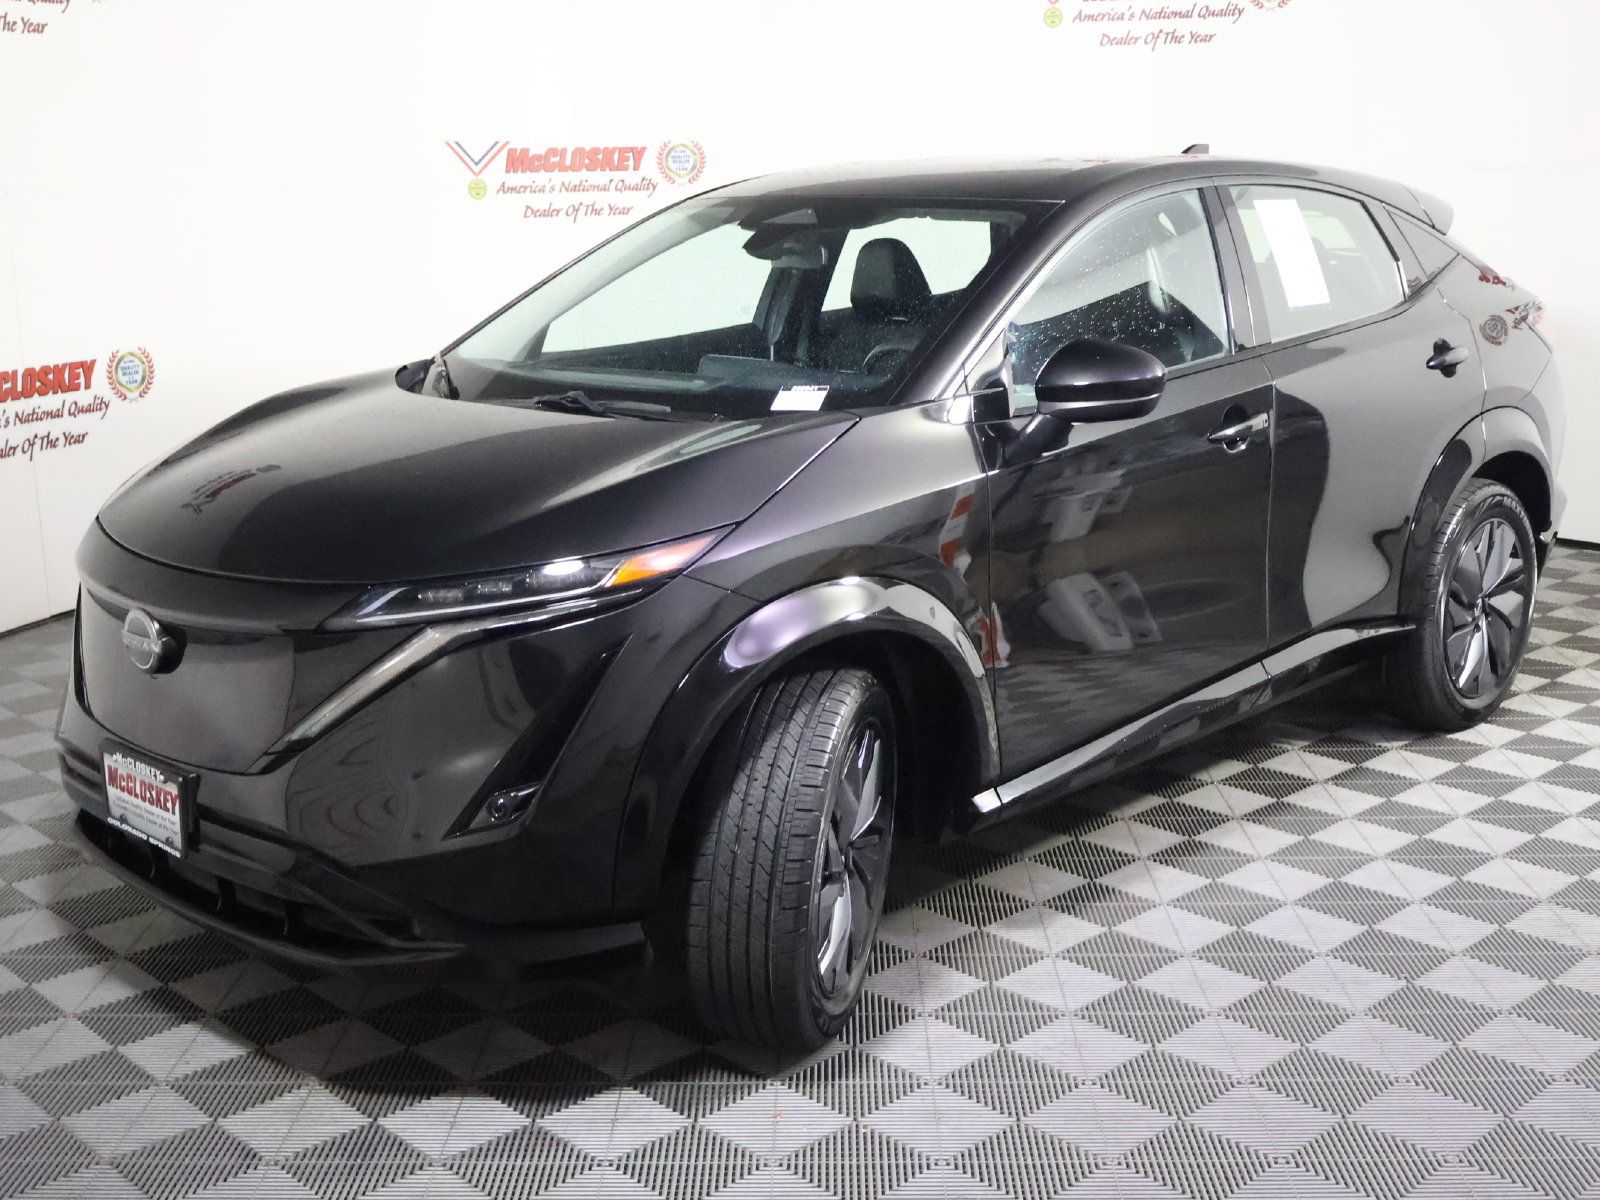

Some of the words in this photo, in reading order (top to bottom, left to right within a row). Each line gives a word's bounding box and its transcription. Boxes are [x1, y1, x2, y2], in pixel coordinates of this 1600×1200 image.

[0, 12, 17, 32] he
[21, 16, 48, 34] Year
[1072, 6, 1135, 23] America's
[1139, 2, 1196, 21] National
[1197, 3, 1245, 24] Quality
[1099, 31, 1141, 47] Dealer
[1144, 29, 1163, 51] Of
[1163, 28, 1185, 45] The
[1188, 30, 1216, 44] Year
[505, 147, 647, 174] McCLOSKEY
[496, 178, 556, 195] America's
[559, 179, 614, 193] National
[615, 176, 658, 198] Quality
[523, 202, 563, 219] Dealer
[566, 202, 583, 224] Of
[584, 200, 604, 217] The
[608, 202, 634, 216] Year
[14, 400, 65, 426] National
[68, 394, 110, 420] Quality
[22, 433, 38, 462] Of
[38, 430, 59, 451] The
[63, 432, 88, 448] Year
[115, 752, 161, 781] McCLOSKEY
[107, 764, 180, 816] McCLOSKEY
[107, 817, 148, 841] COLORADO
[149, 837, 181, 858] SPRINGS
